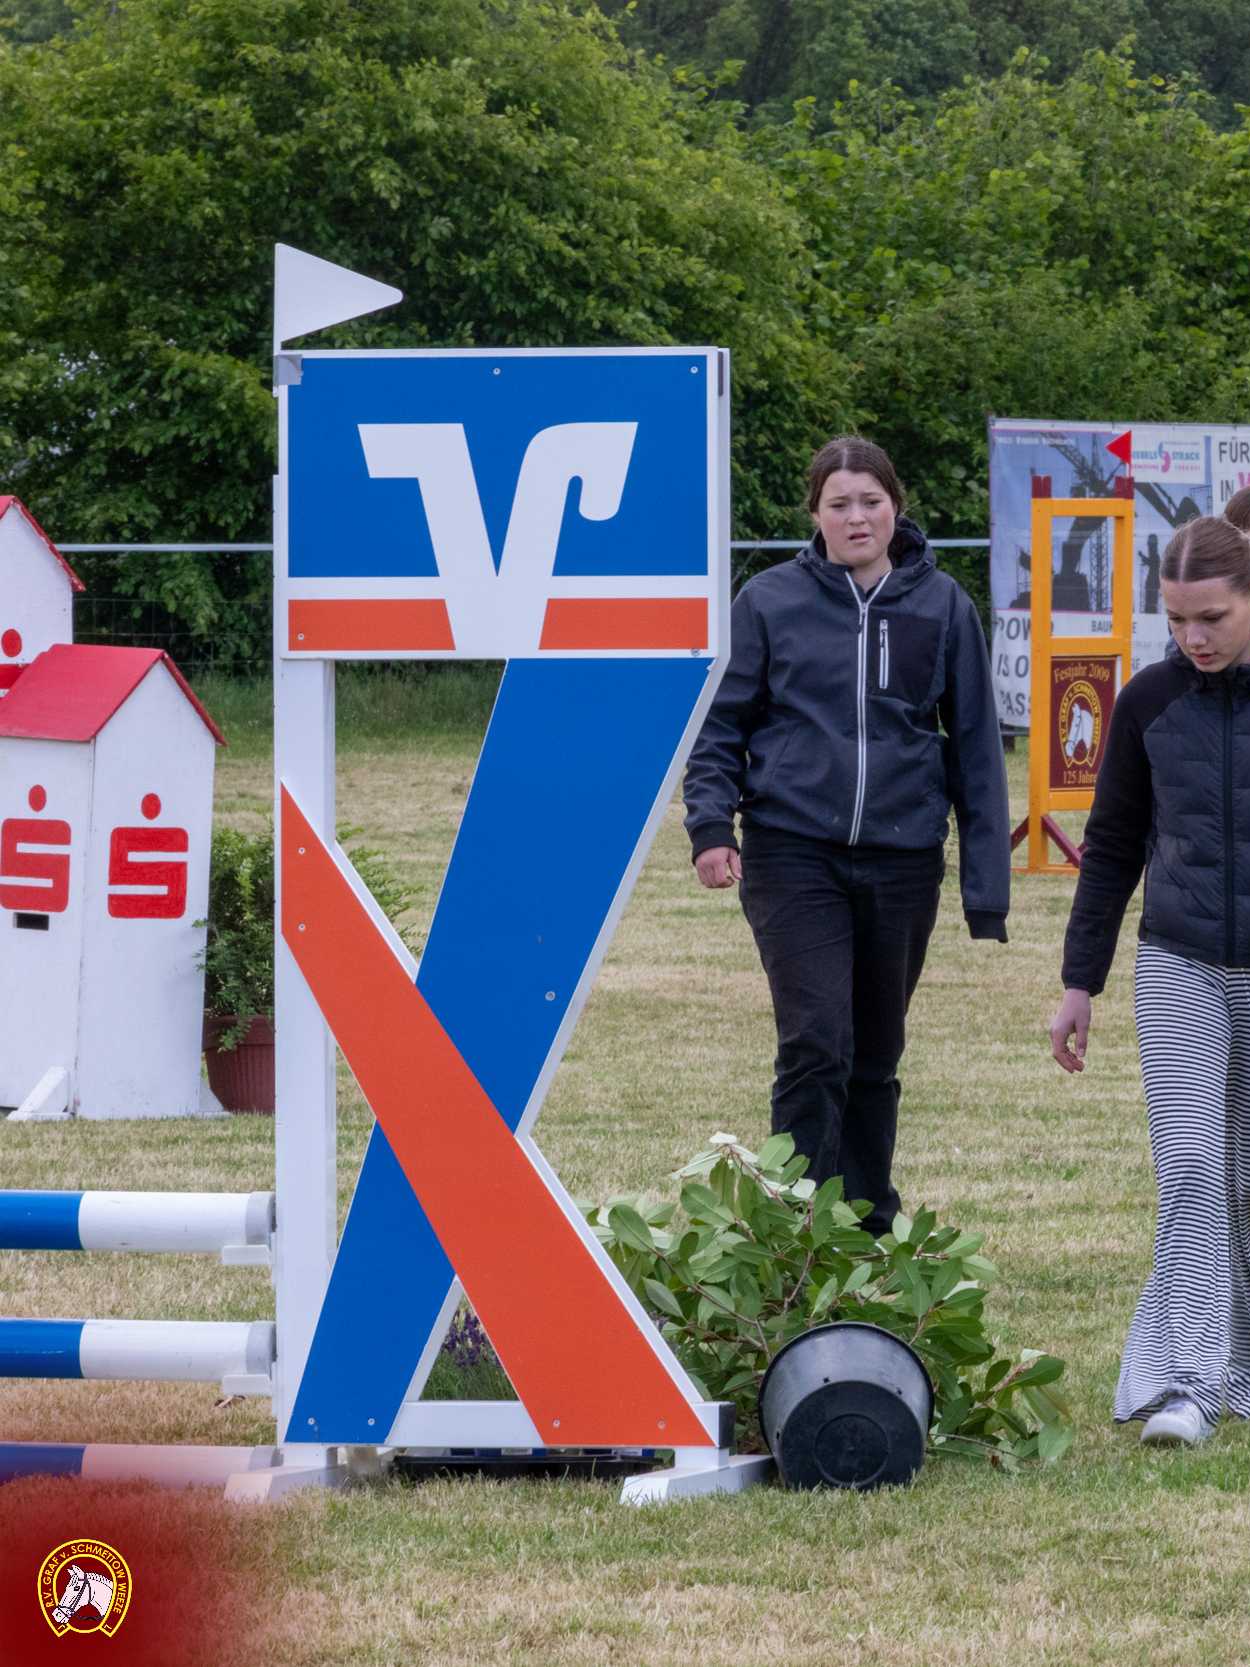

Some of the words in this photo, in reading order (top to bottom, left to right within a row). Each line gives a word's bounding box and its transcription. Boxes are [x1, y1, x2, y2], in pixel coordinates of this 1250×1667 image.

[1219, 437, 1249, 463] FÜR
[1220, 480, 1234, 502] IN
[1054, 663, 1088, 683] Festjahr
[1088, 663, 1110, 682] 2009
[1063, 771, 1077, 784] 125
